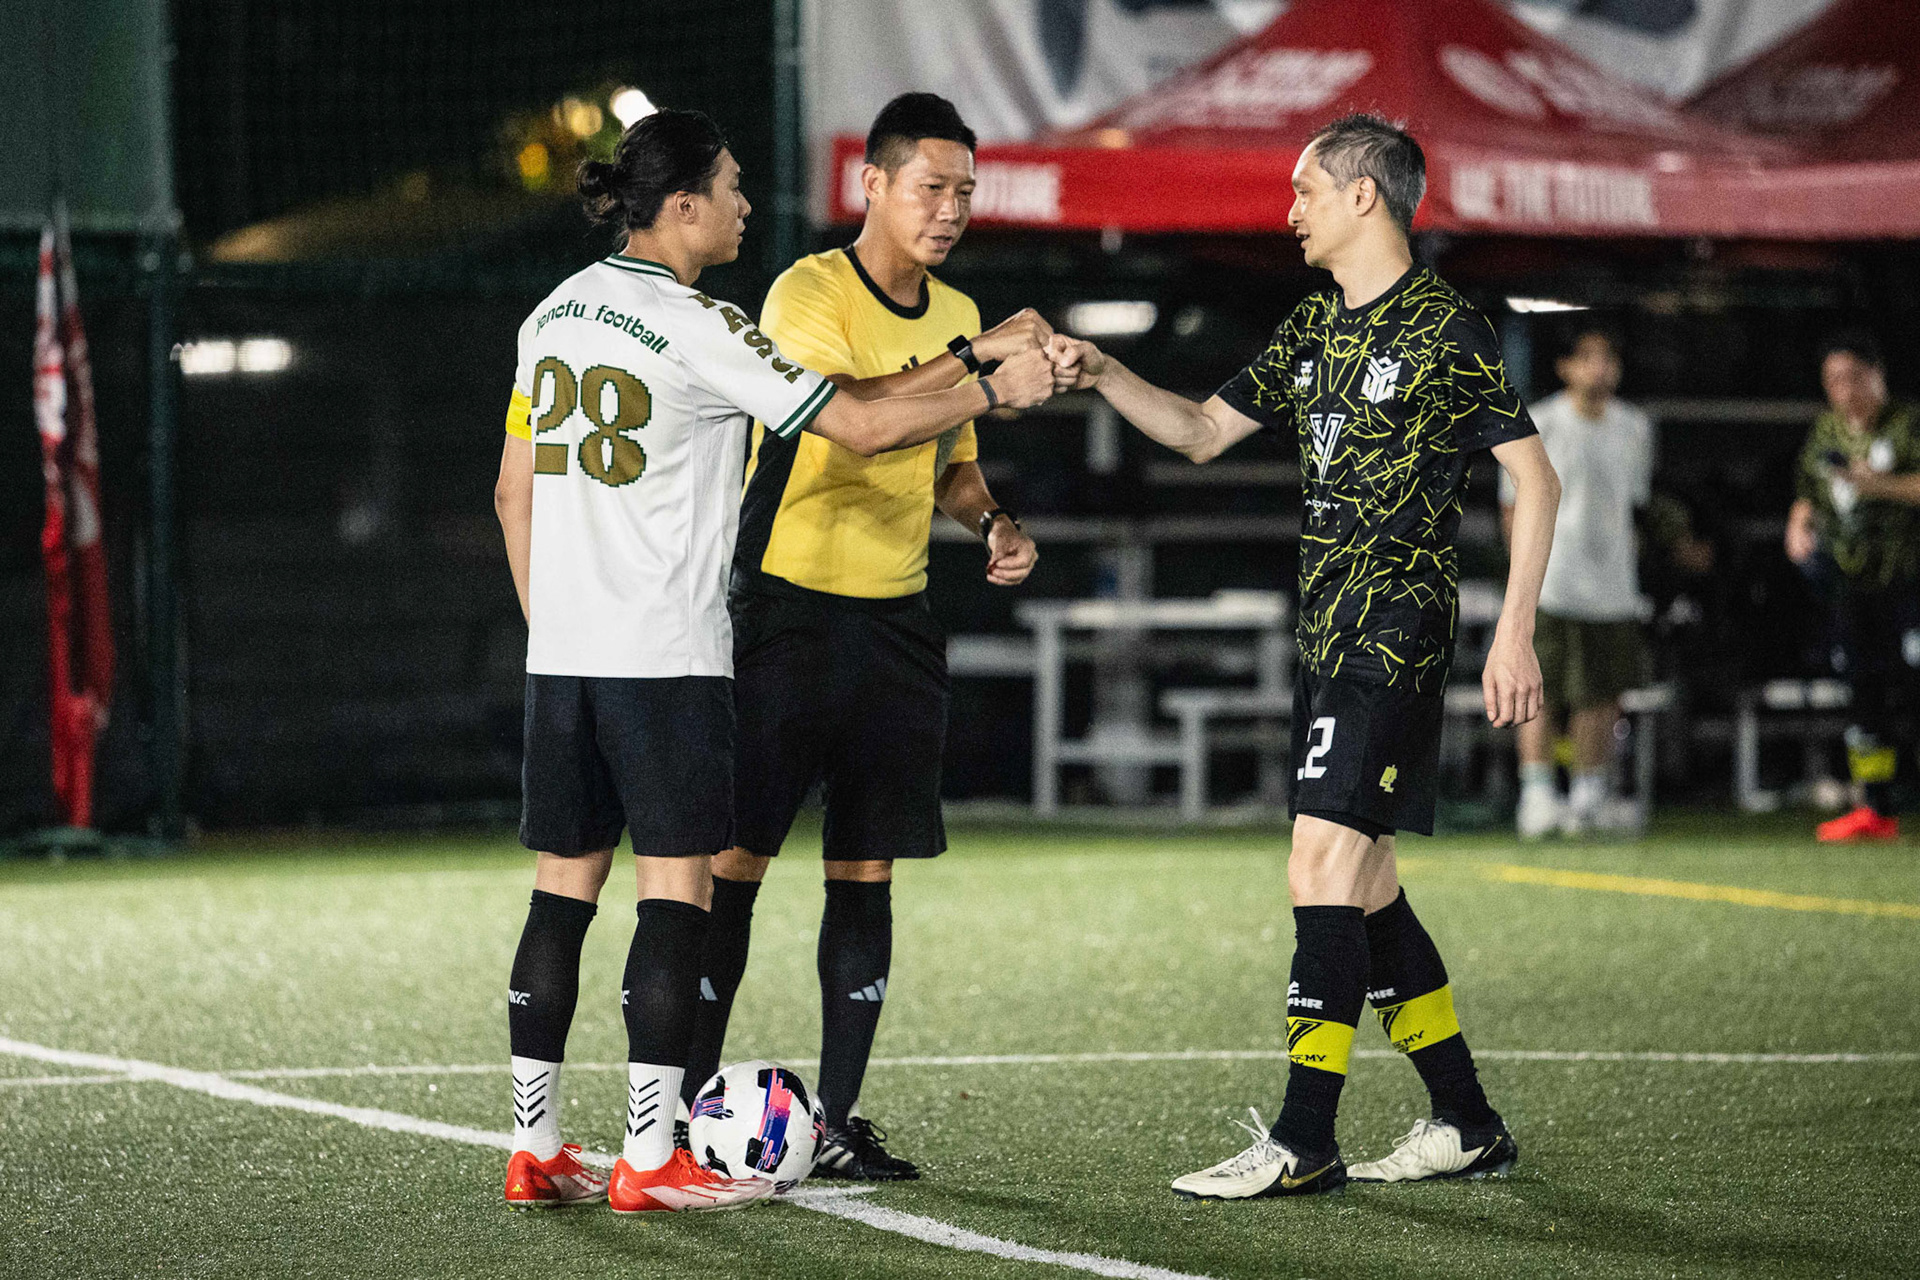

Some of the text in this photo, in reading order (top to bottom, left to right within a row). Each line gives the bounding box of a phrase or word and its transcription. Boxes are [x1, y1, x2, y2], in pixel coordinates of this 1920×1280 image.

[535, 299, 670, 354] jenofu_football
[531, 356, 652, 488] 28
[1297, 716, 1336, 781] 2
